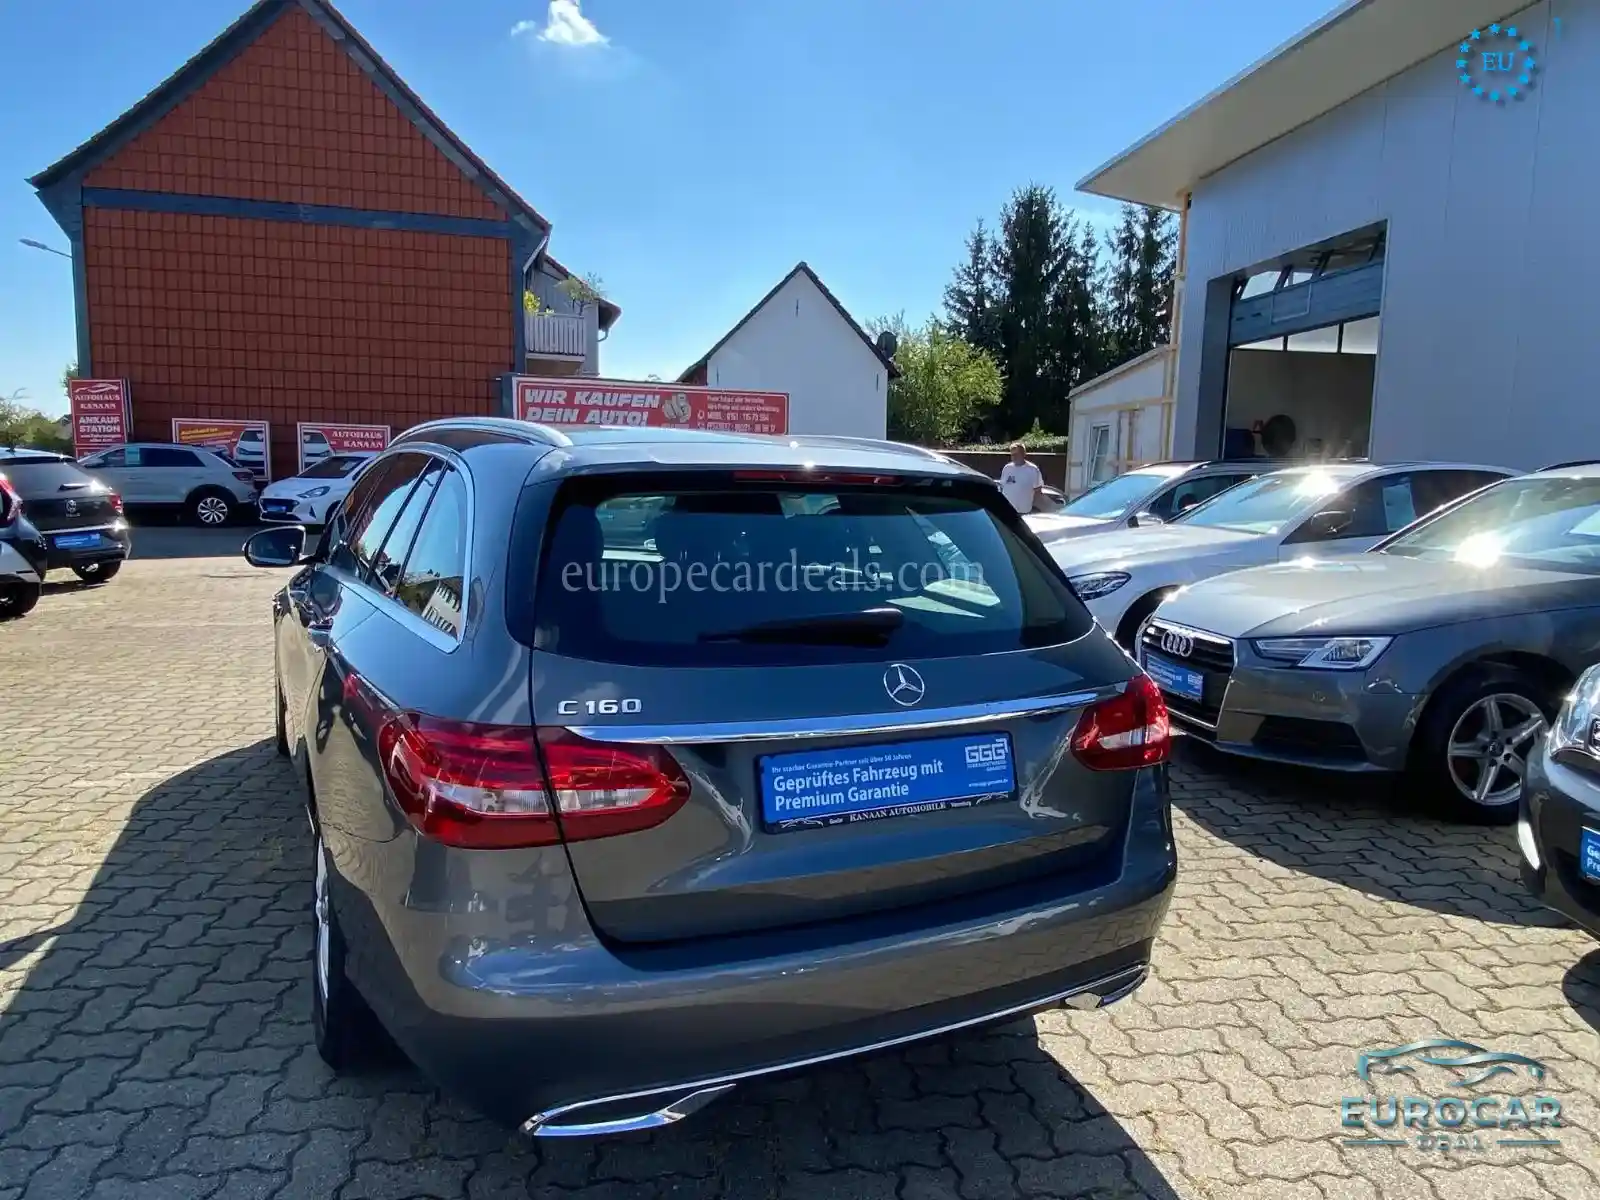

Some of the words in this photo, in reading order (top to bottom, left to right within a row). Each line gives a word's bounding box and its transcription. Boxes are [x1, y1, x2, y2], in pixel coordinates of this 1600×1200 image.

[525, 389, 567, 404] WIR
[574, 391, 660, 409] KAUFEN
[79, 416, 120, 424] ANKAUF
[526, 407, 579, 422] DEIN
[584, 410, 649, 427] AUTO!
[332, 430, 383, 439] AUTOHAUS
[343, 440, 383, 448] KANAAN
[557, 700, 579, 715] C
[585, 698, 642, 715] 160
[773, 769, 849, 794] Geprüftes
[853, 764, 918, 783] Fahrzeug
[921, 759, 944, 775] mit
[775, 791, 845, 811] Premium
[848, 781, 909, 802] Garantie
[849, 809, 888, 822] KANAAN
[889, 801, 947, 817] AUTOMOBILE
